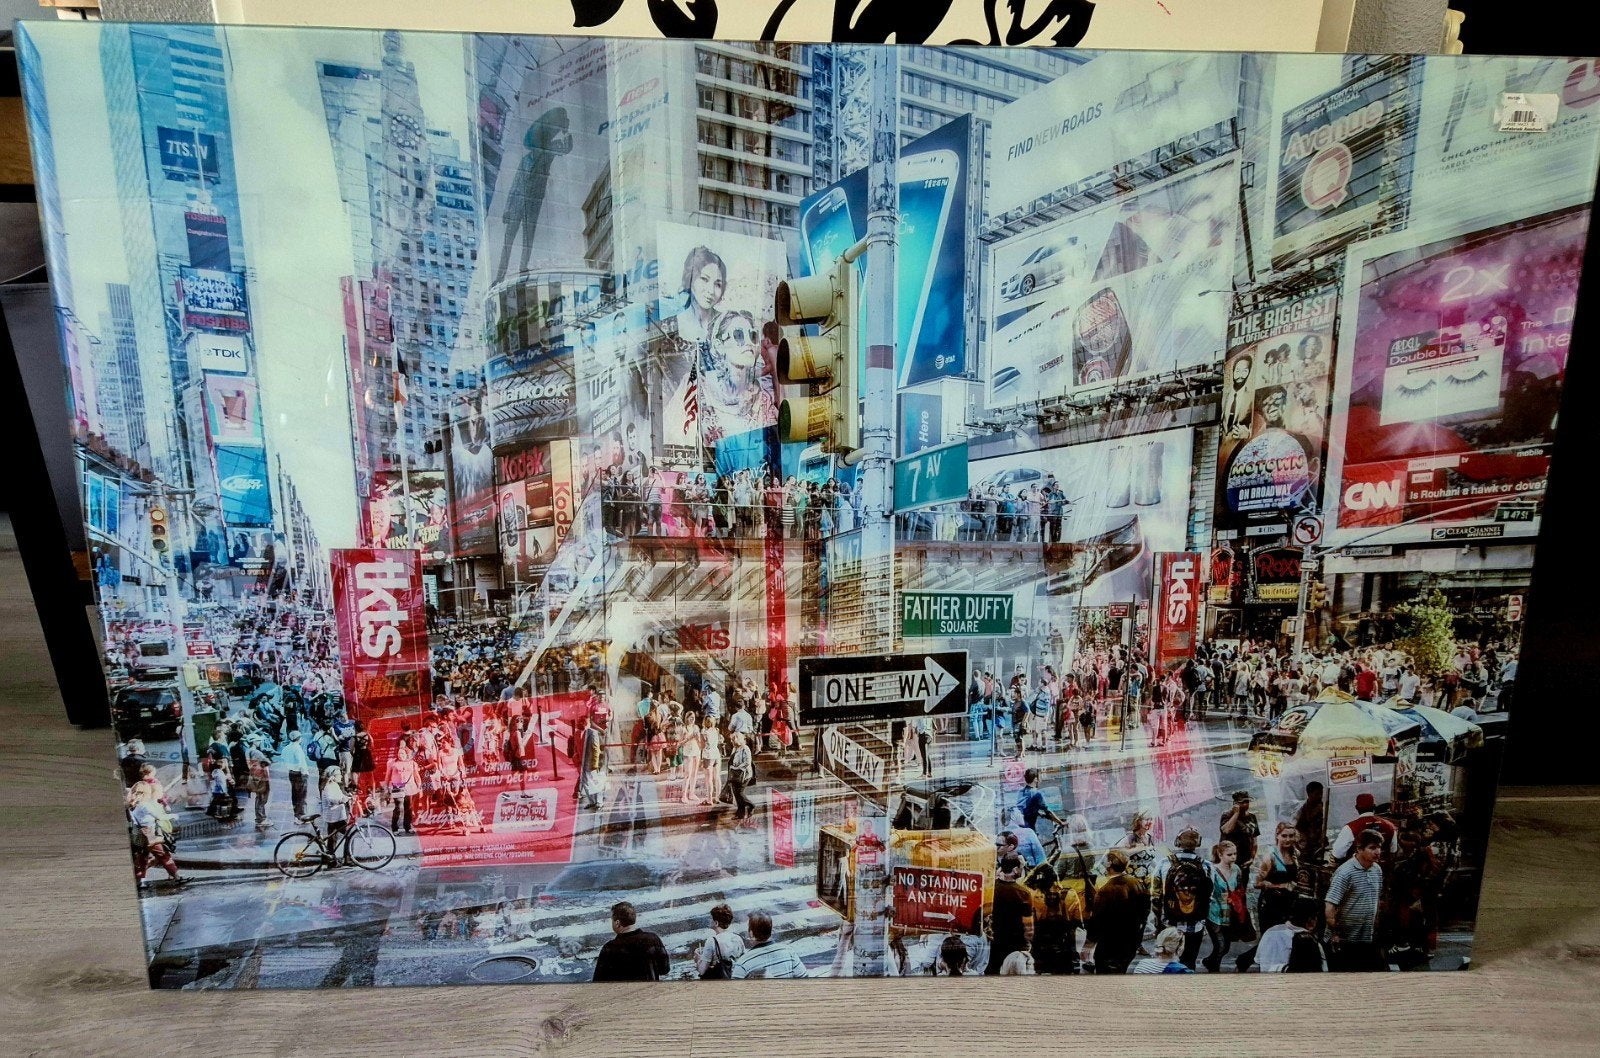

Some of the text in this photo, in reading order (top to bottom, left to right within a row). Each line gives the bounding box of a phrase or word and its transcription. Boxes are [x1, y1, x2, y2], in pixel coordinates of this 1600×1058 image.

[1007, 136, 1034, 162] FIND
[1061, 102, 1103, 136] ROADS
[1282, 100, 1384, 166] Avenue
[1300, 141, 1353, 211] Q
[187, 314, 250, 331] TOSHIBA
[1228, 295, 1334, 338] THE BIGGEST
[1521, 320, 1543, 330] The
[1231, 336, 1246, 348] BOX
[1246, 329, 1269, 343] OFFICE
[1270, 327, 1282, 338] HIT
[1295, 319, 1309, 332] THE
[212, 348, 241, 359] TDK
[1389, 349, 1438, 367] Double
[501, 446, 544, 481] Kodak
[1230, 455, 1304, 478] MOTOWN
[908, 453, 942, 502] 7 AV
[1421, 486, 1460, 499] Rouhani
[1471, 481, 1501, 495] hawk
[1502, 483, 1513, 492] or
[1514, 478, 1548, 491] dove?
[1238, 483, 1293, 501] ON BROADWAY
[1344, 479, 1401, 511] CNN
[1510, 509, 1520, 519] 47
[1168, 558, 1194, 625] tkts
[355, 558, 409, 658] tkts
[904, 596, 1012, 621] FATHER DUFFY
[940, 620, 980, 634] SQUARE
[826, 673, 945, 704] ONE WAY
[830, 731, 880, 784] ONE WAY
[1331, 758, 1367, 768] HOT DOG
[481, 775, 503, 786] THRU
[898, 873, 978, 892] NO STANDING
[907, 890, 968, 909] ANYTIME
